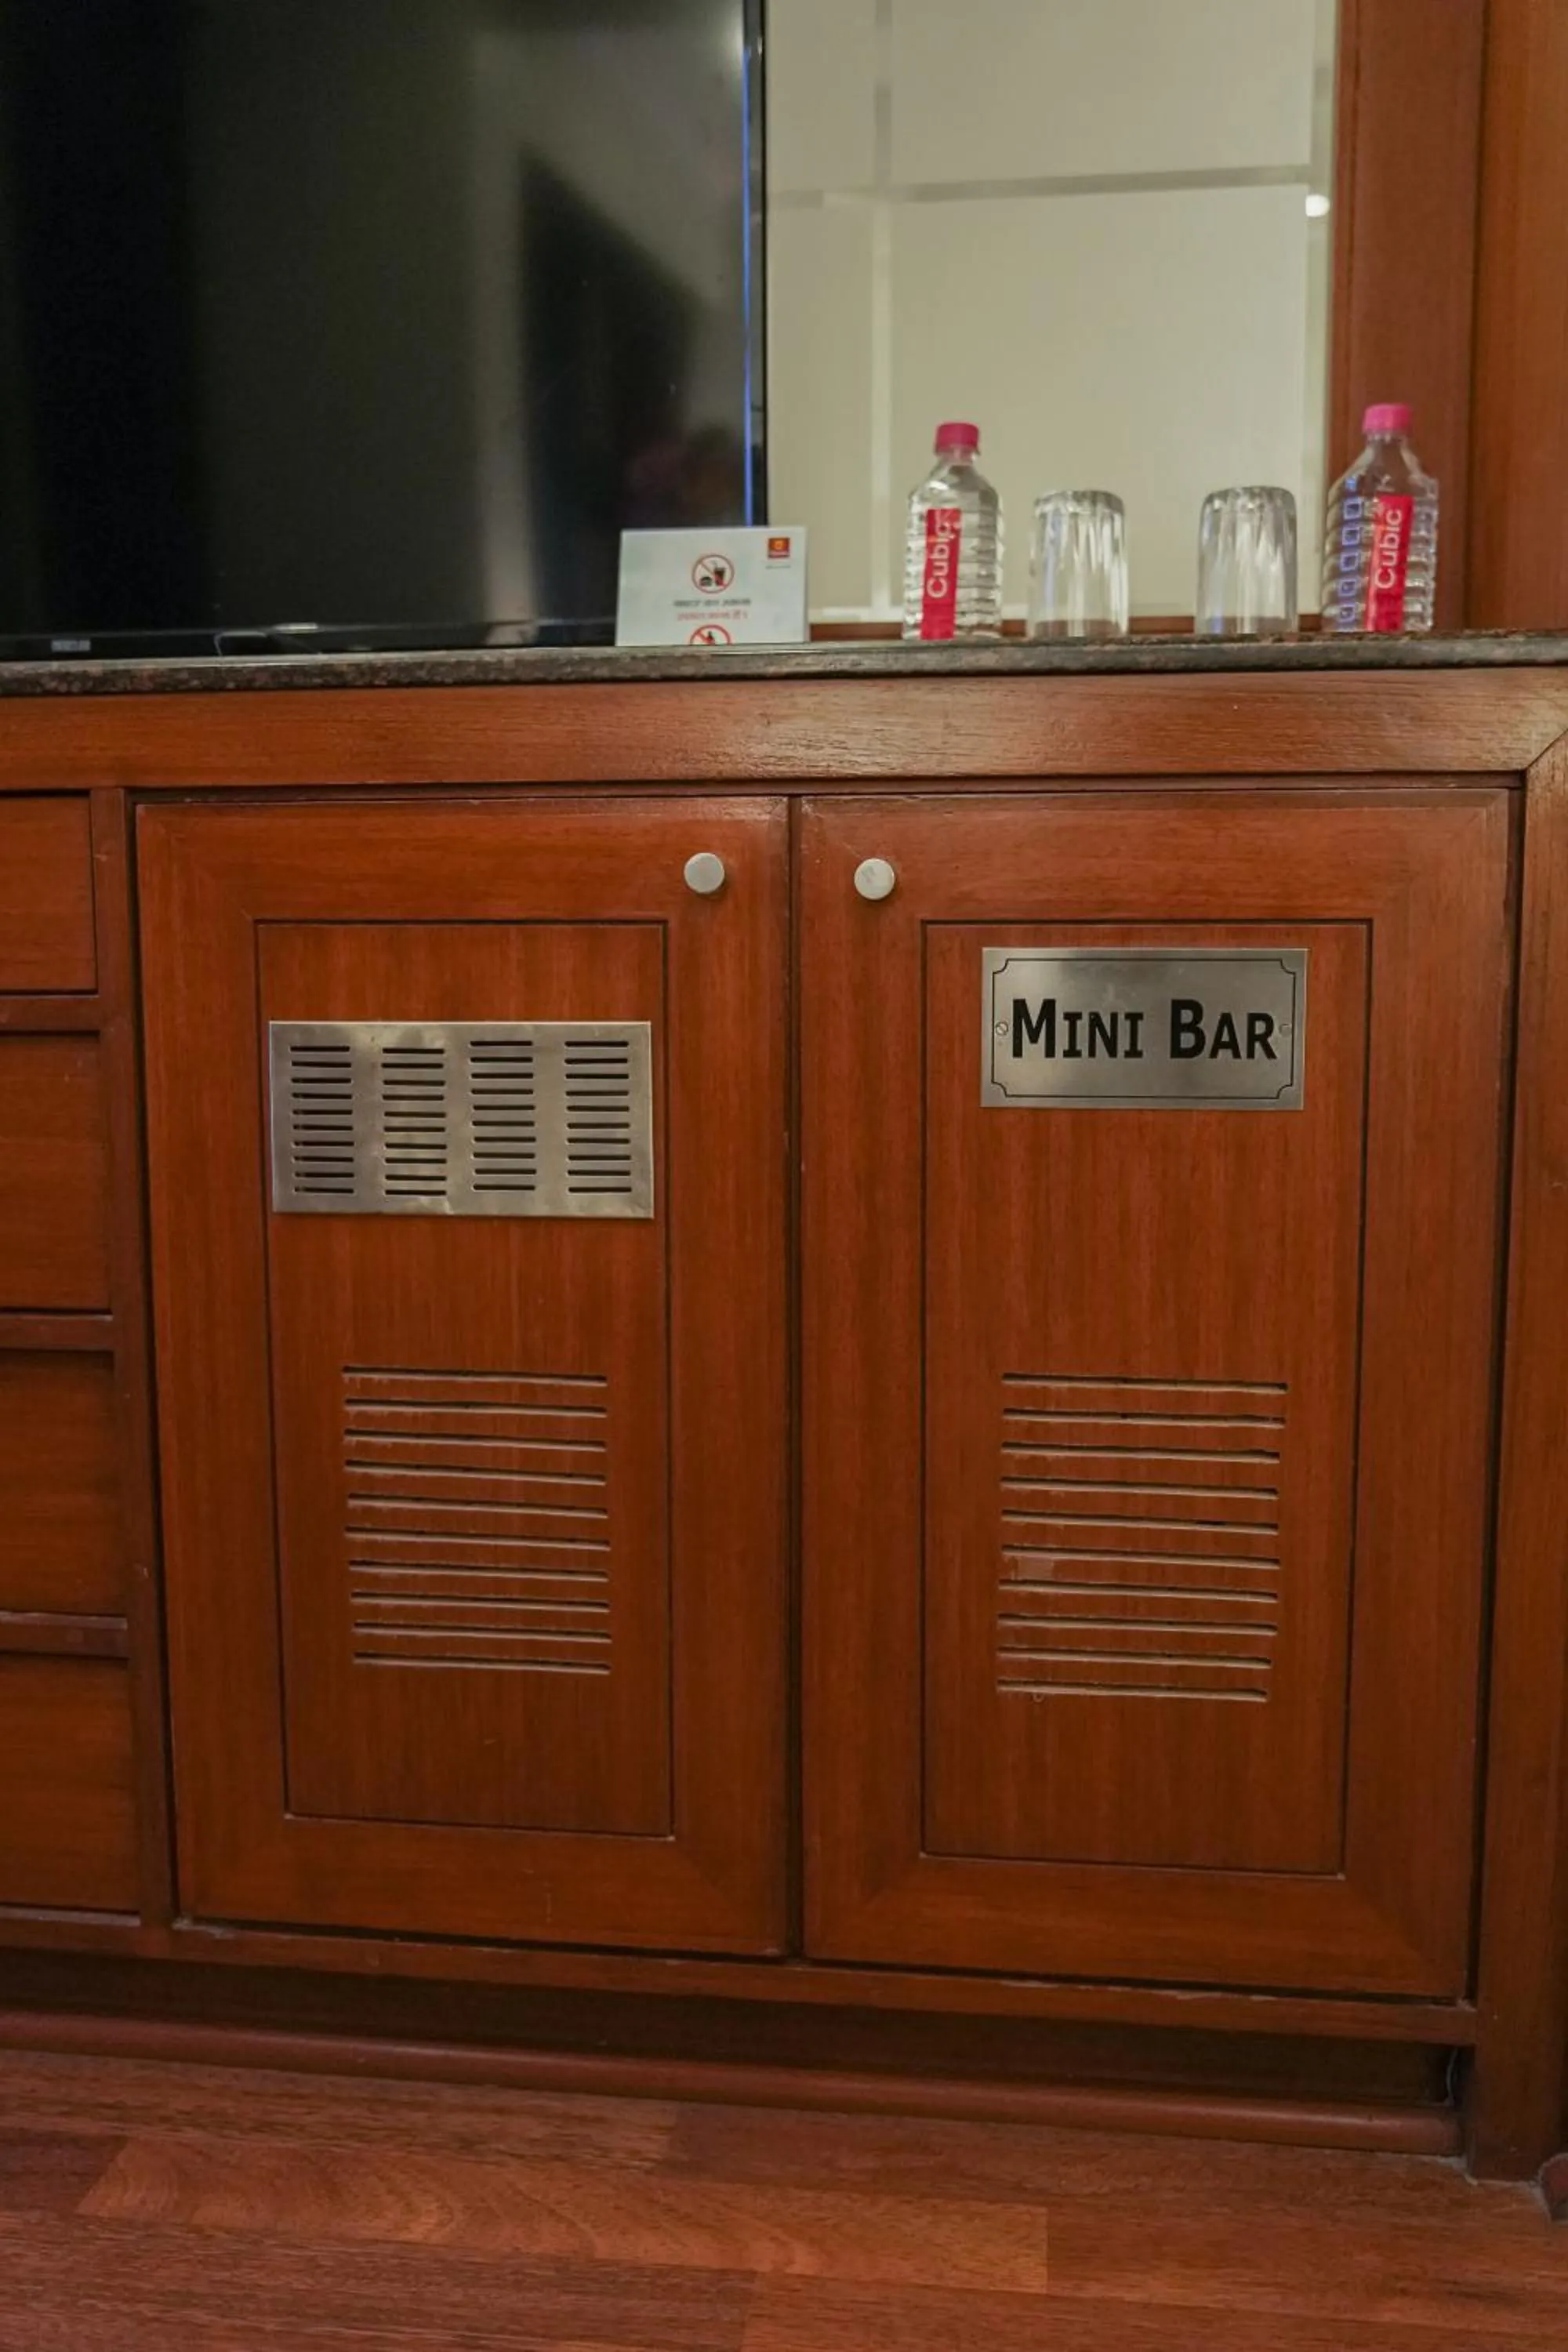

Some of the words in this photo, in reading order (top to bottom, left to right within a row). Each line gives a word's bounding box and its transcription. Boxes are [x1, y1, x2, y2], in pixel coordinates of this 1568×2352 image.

[1374, 508, 1403, 589] Cubic
[1011, 998, 1145, 1059] MINI
[1169, 998, 1278, 1060] BAR
